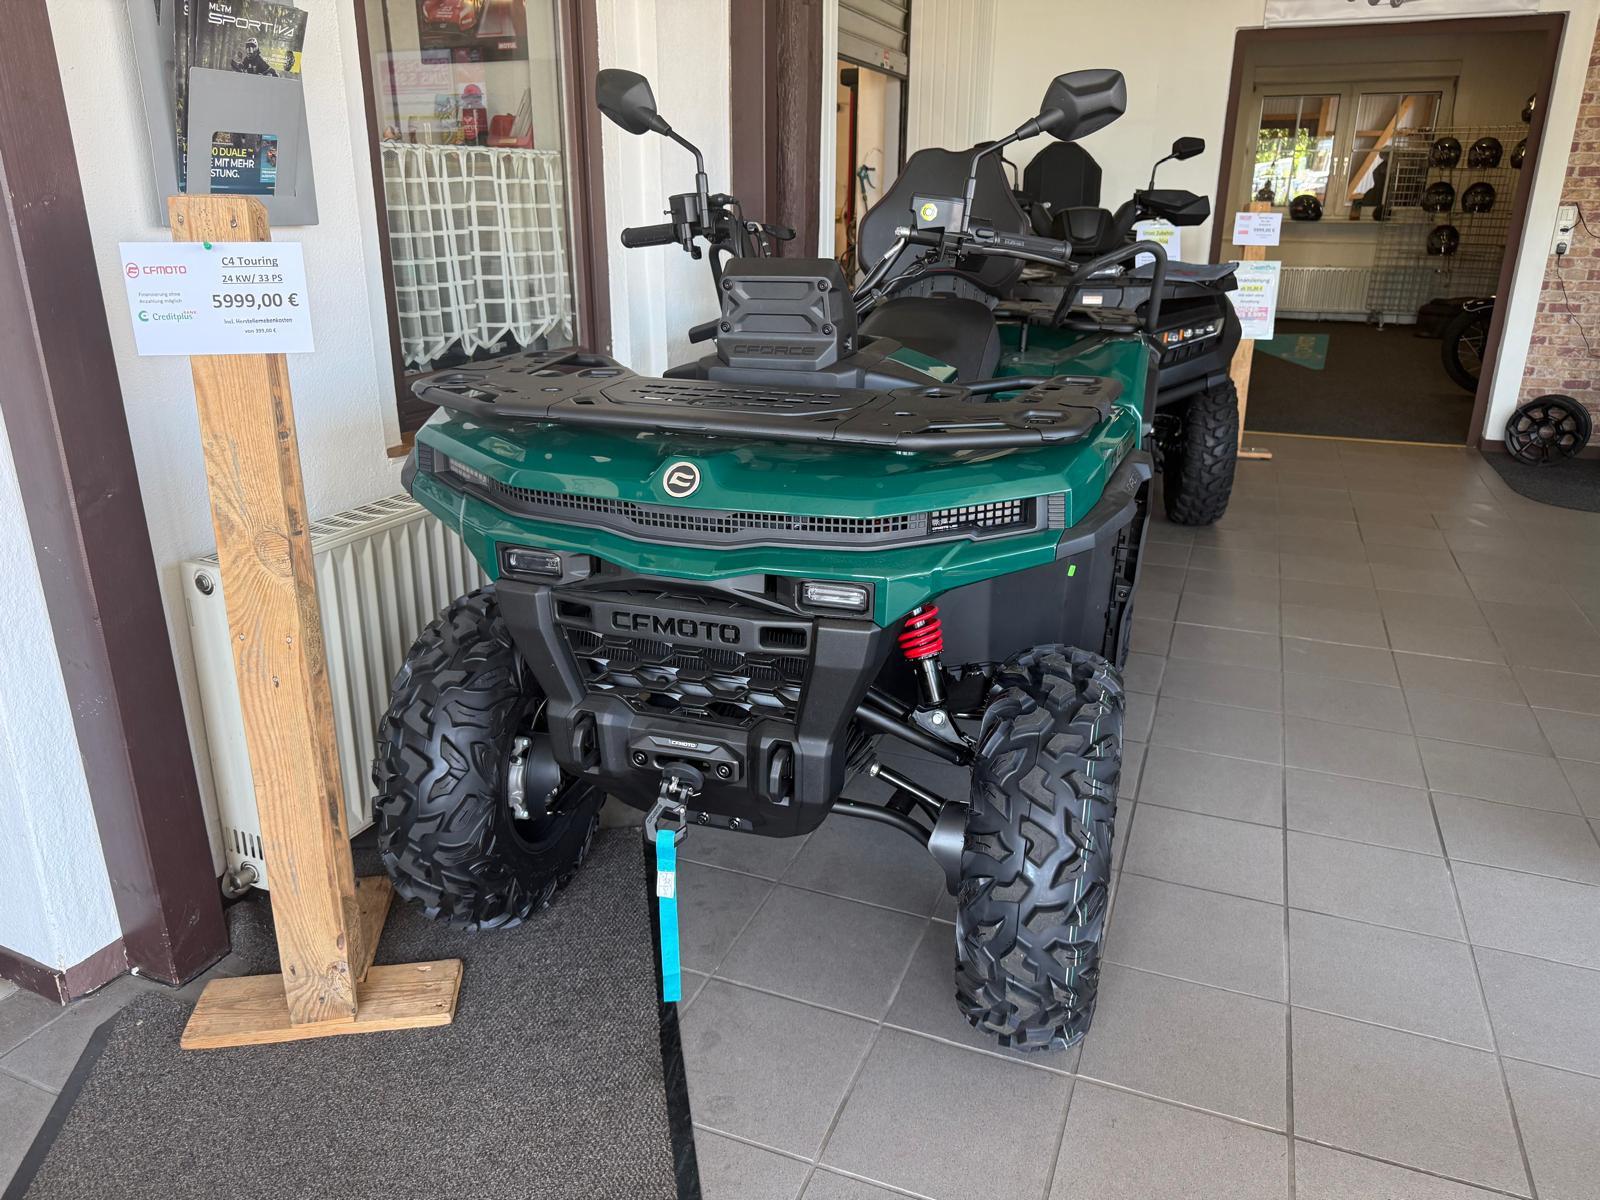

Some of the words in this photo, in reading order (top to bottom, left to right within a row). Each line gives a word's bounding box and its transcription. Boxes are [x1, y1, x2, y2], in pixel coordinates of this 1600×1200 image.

[209, 2, 232, 13] MLTM
[208, 12, 295, 37] SPORTIVA
[219, 147, 247, 157] DUALE
[214, 158, 230, 167] MIT
[230, 158, 255, 168] MEHR
[221, 257, 235, 266] C4
[237, 256, 279, 267] Touring
[143, 265, 187, 275] CFMOTO
[222, 274, 234, 283] 24
[258, 274, 270, 282] 33
[271, 273, 283, 282] PS
[212, 293, 283, 310] 5999,00
[287, 293, 300, 307] €
[152, 311, 193, 323] Creditplus
[734, 344, 816, 355] CFORCE
[610, 610, 742, 645] CFMOTO
[671, 740, 697, 748] CFMOTO
